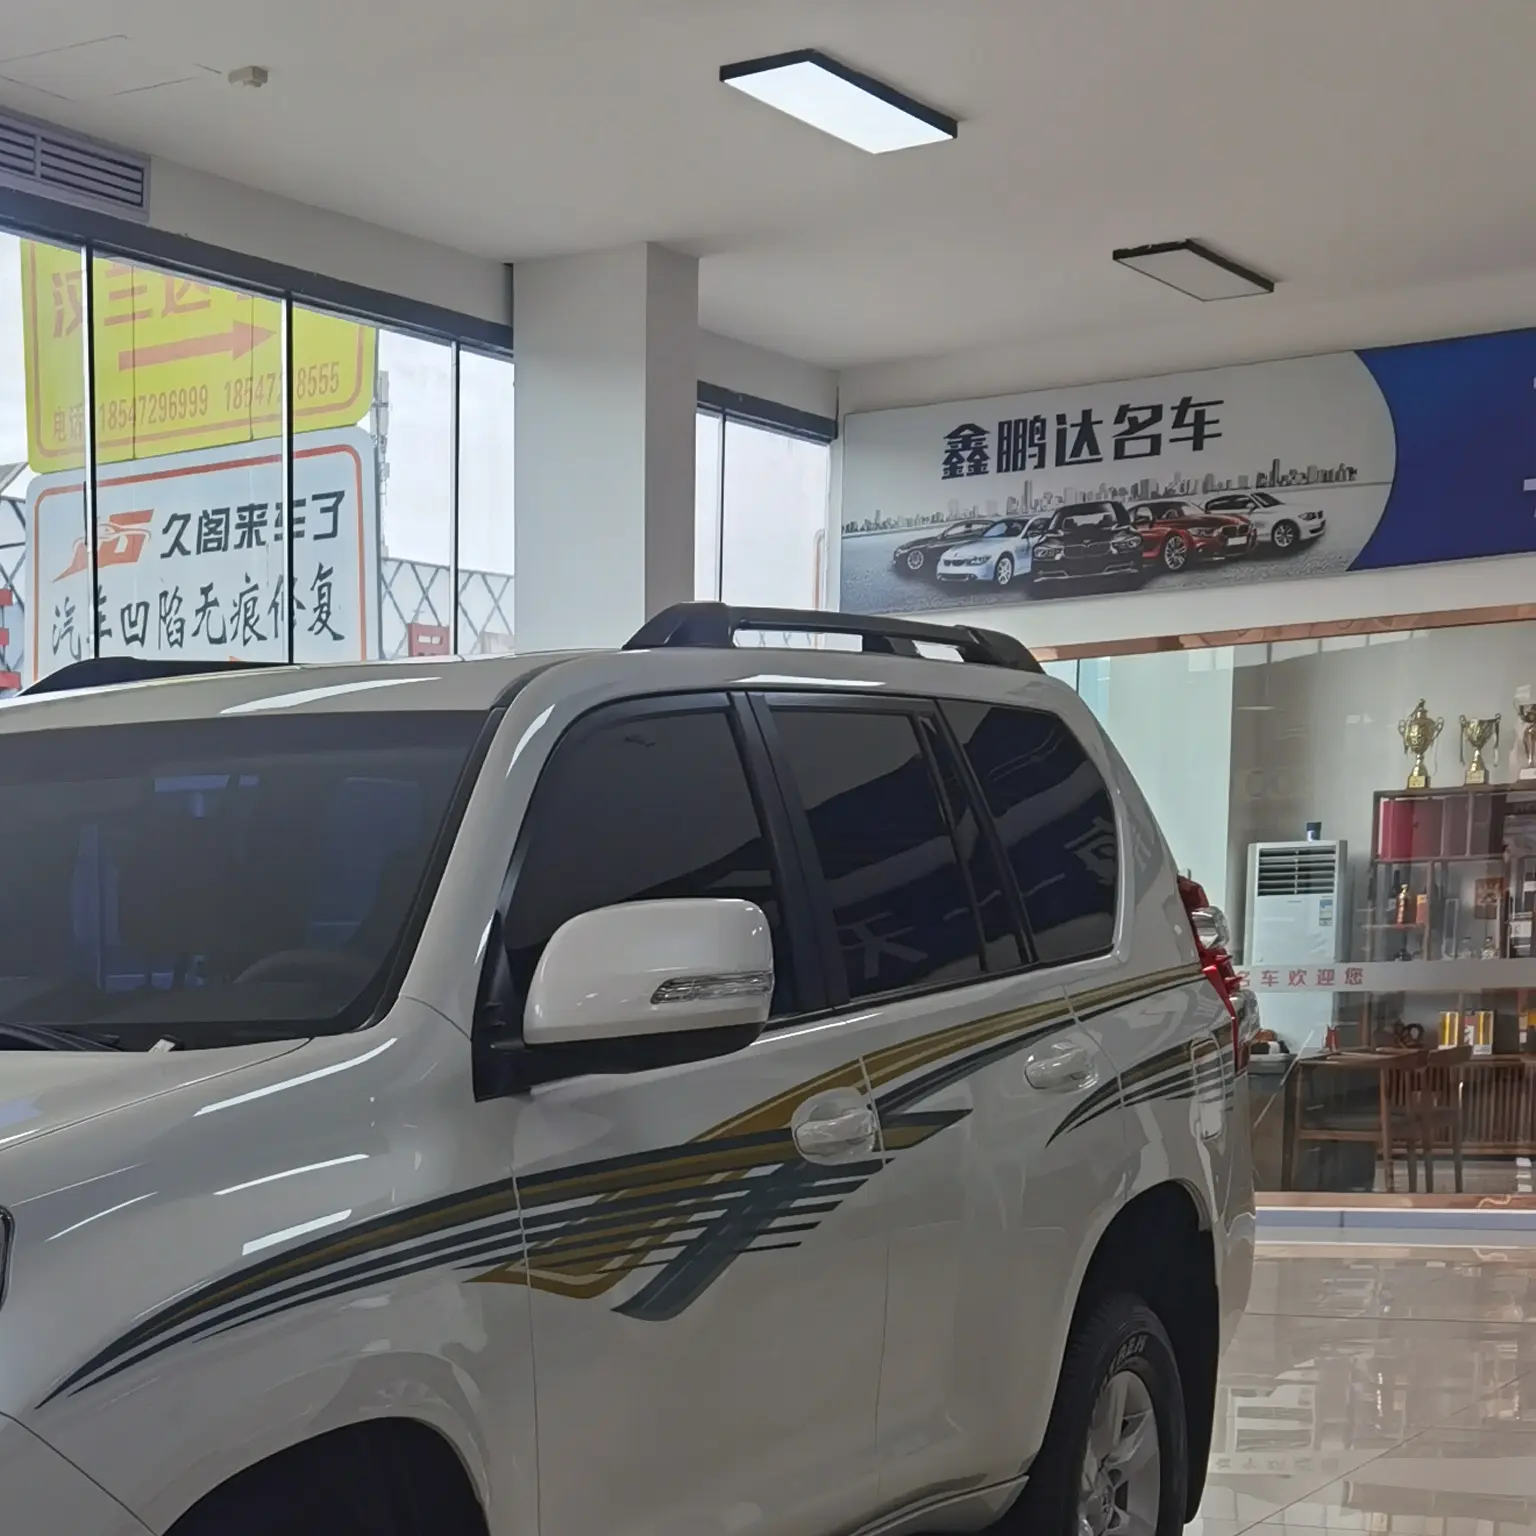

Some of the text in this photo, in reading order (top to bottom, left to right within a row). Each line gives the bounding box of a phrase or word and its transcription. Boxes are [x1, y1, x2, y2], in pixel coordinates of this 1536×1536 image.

[100, 385, 208, 432] 18547296999
[225, 361, 340, 411] 185478555
[941, 396, 1224, 480] 鑫鹏达名车
[160, 490, 346, 559] 久阁来车了
[52, 562, 345, 660] 汽车凹陷无痕修复
